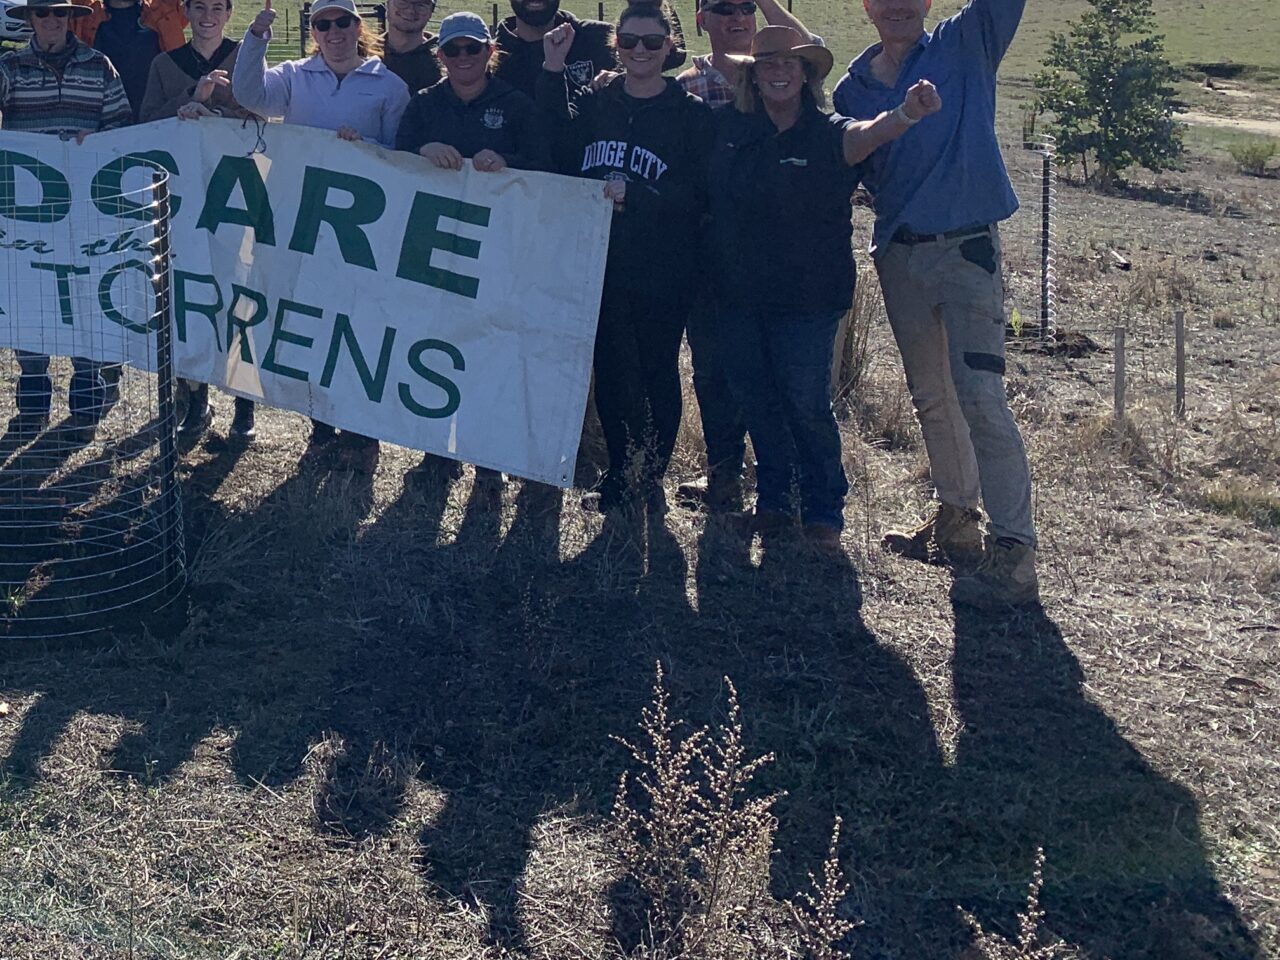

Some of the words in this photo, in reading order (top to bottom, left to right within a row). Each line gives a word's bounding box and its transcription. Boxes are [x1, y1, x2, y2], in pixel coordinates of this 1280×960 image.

[630, 145, 668, 180] CITY
[80, 227, 176, 257] th
[30, 257, 466, 420] TORRENS
